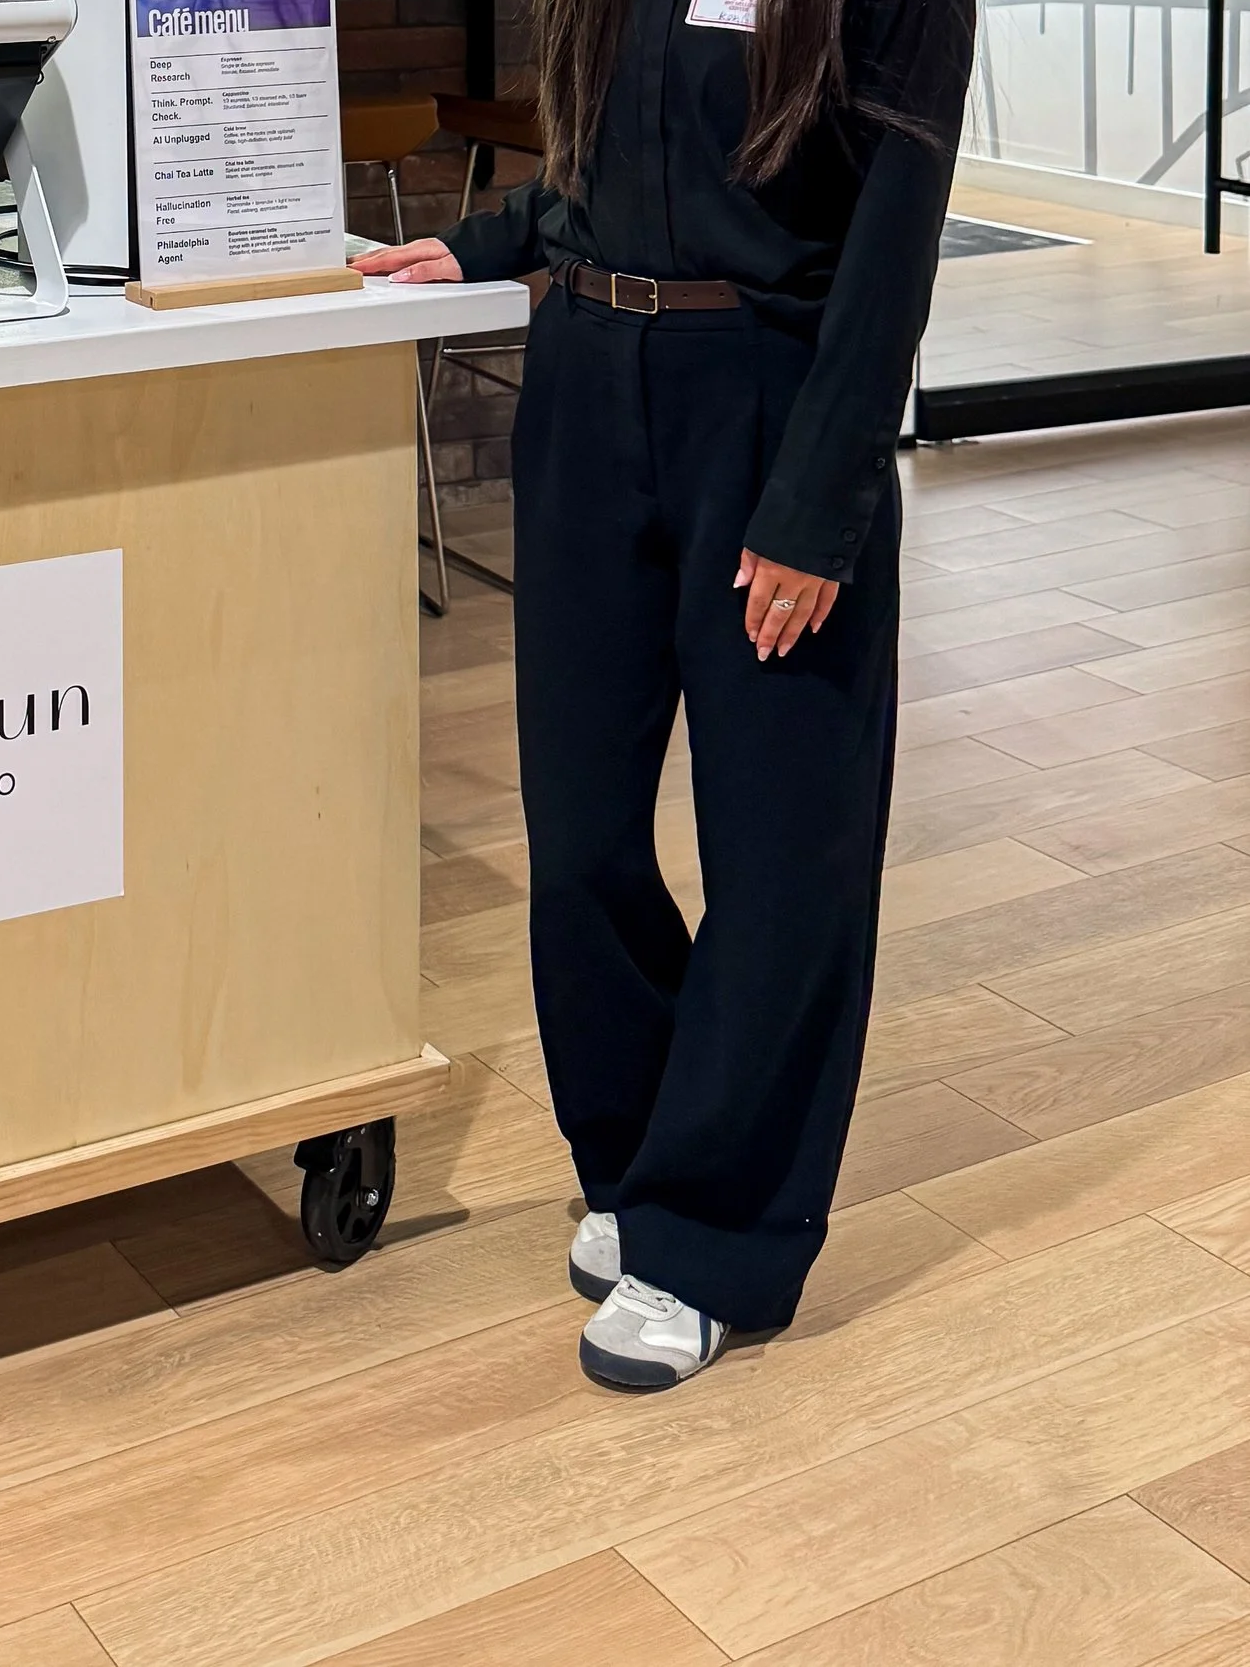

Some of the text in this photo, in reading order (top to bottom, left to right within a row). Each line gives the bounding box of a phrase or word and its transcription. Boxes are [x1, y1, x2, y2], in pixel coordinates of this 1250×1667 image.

[148, 7, 250, 37] Café menu
[150, 60, 172, 70] Deep
[150, 72, 191, 83] Research
[150, 98, 178, 108] Think.
[179, 97, 214, 107] Prompt.
[152, 112, 182, 122] Check.
[152, 136, 163, 145] AI
[164, 132, 211, 146] Unplugged
[154, 170, 174, 181] Chai
[176, 170, 192, 179] Tea
[193, 168, 214, 178] Latte
[156, 200, 212, 212] Hallucination
[156, 216, 176, 226] Free
[157, 238, 210, 250] Philadelphia
[158, 254, 184, 266] Agent
